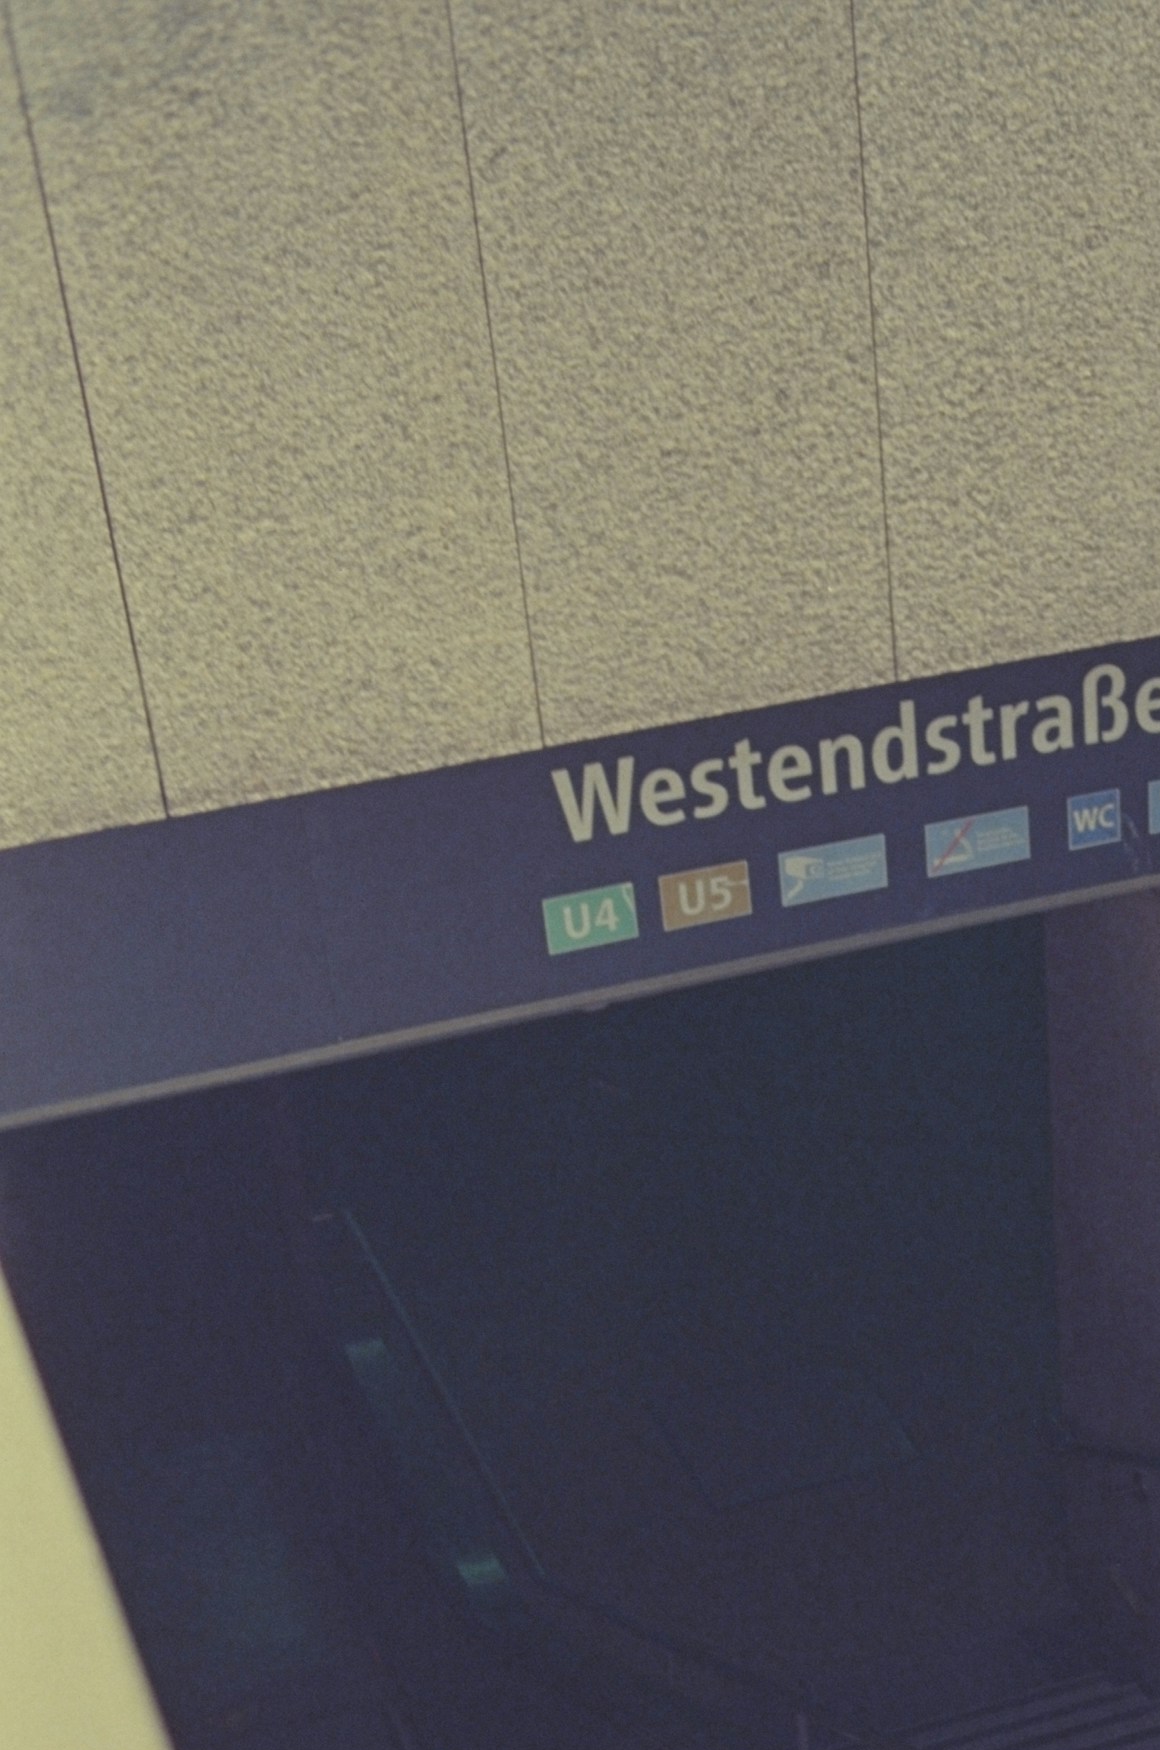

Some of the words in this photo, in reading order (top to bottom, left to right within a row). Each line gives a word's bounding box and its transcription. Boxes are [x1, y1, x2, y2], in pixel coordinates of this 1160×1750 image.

[1073, 802, 1116, 834] WC
[678, 874, 733, 918] U5
[562, 897, 620, 941] U4
